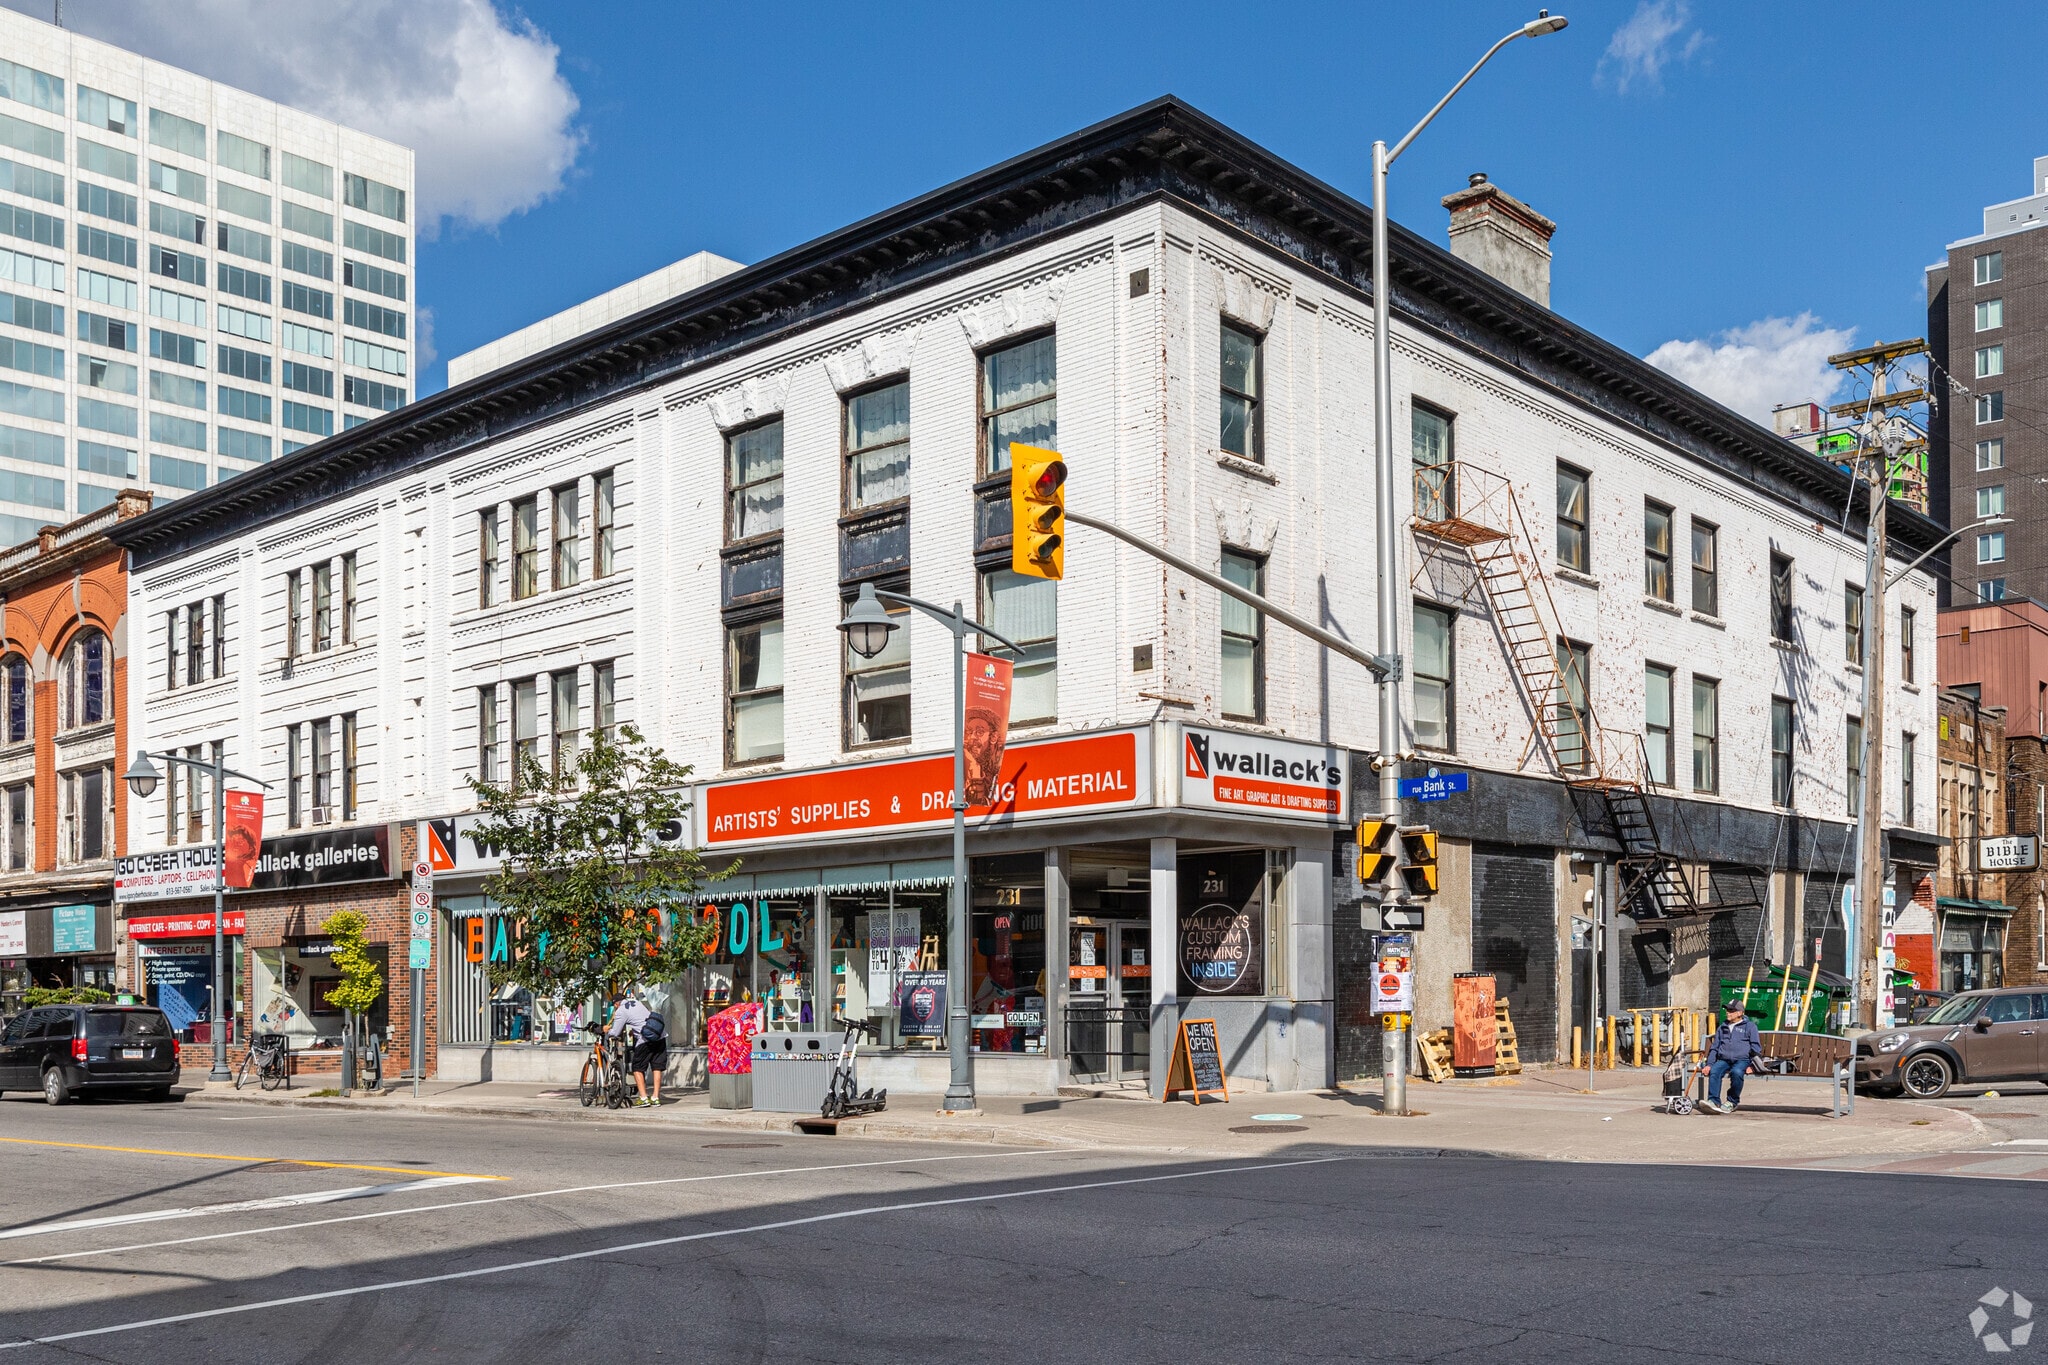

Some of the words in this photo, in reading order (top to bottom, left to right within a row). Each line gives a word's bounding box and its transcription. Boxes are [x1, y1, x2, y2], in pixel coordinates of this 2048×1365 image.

[1213, 751, 1342, 786] wallack's
[1424, 778, 1444, 792] Bank
[1448, 781, 1456, 790] St.
[714, 805, 782, 833] ARTISTS'
[791, 799, 871, 825] SUPPLIES
[890, 795, 900, 814] &
[1027, 769, 1128, 800] MATERIAL
[1218, 786, 1232, 800] FINE
[1246, 790, 1270, 804] GRAPHIC
[1270, 794, 1280, 804] ART
[1282, 795, 1286, 806] &
[1287, 796, 1312, 808] DRAFTING
[1312, 798, 1336, 811] SUPPLIES
[1986, 845, 2028, 857] BIBLE
[137, 853, 180, 873] CYBER
[254, 851, 300, 873] allack
[304, 844, 379, 872] galleries
[1990, 858, 2026, 866] HOUSE
[123, 876, 154, 888] COMPUTERS
[158, 872, 182, 885] LAPTOPS
[1203, 880, 1224, 893] 231
[996, 888, 1020, 906] 231
[129, 923, 152, 934] INTERNET
[152, 922, 164, 933] CAFE
[168, 920, 193, 932] PRINTING
[196, 920, 211, 930] COPY
[234, 918, 244, 928] FAX
[897, 912, 908, 928] TO
[994, 916, 1011, 928] OPEN
[1181, 915, 1250, 930] WALLACK'S
[1187, 930, 1240, 944] CUSTOM
[144, 946, 182, 955] INTERNET
[184, 944, 206, 954] CAFÉ
[872, 950, 879, 960] UP
[1186, 946, 1242, 960] FRAMING
[872, 960, 880, 970] TO
[1192, 962, 1237, 978] INSIDE
[1008, 1013, 1039, 1022] GOLDEN
[1186, 1024, 1200, 1036] WE
[1200, 1022, 1215, 1037] ARE
[1190, 1038, 1216, 1052] OPEN
